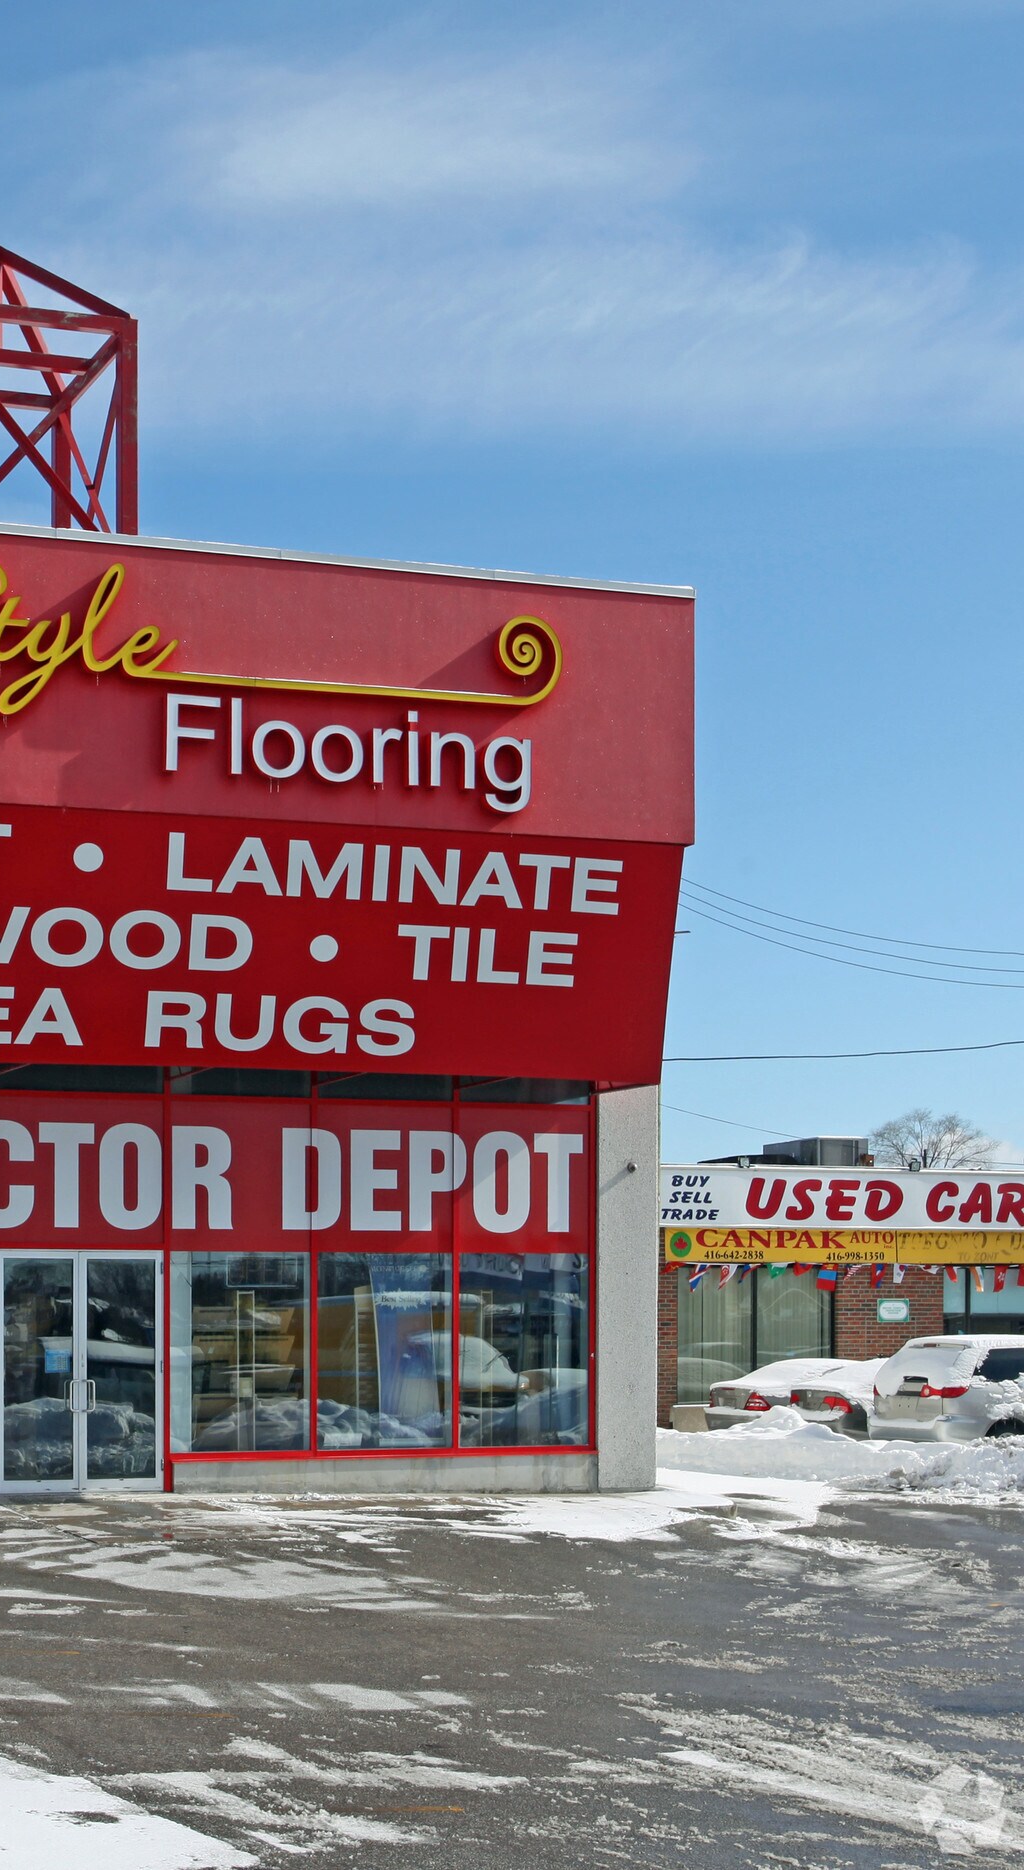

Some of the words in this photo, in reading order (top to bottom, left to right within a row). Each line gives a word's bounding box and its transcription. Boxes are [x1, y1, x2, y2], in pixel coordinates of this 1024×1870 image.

[165, 693, 532, 813] Flooring
[166, 832, 624, 916] LAMINATE
[397, 924, 579, 988] TILE
[144, 990, 415, 1057] RUGS
[282, 1128, 584, 1234] DEPOT
[671, 1175, 710, 1188] BUY
[669, 1191, 713, 1204] SELL
[745, 1177, 904, 1222] USED
[661, 1208, 720, 1221] TRADE
[695, 1229, 846, 1249] CANPAK
[849, 1231, 894, 1244] AUTO
[704, 1250, 765, 1260] 416-642-2838
[826, 1251, 885, 1262] 416-998-1350
